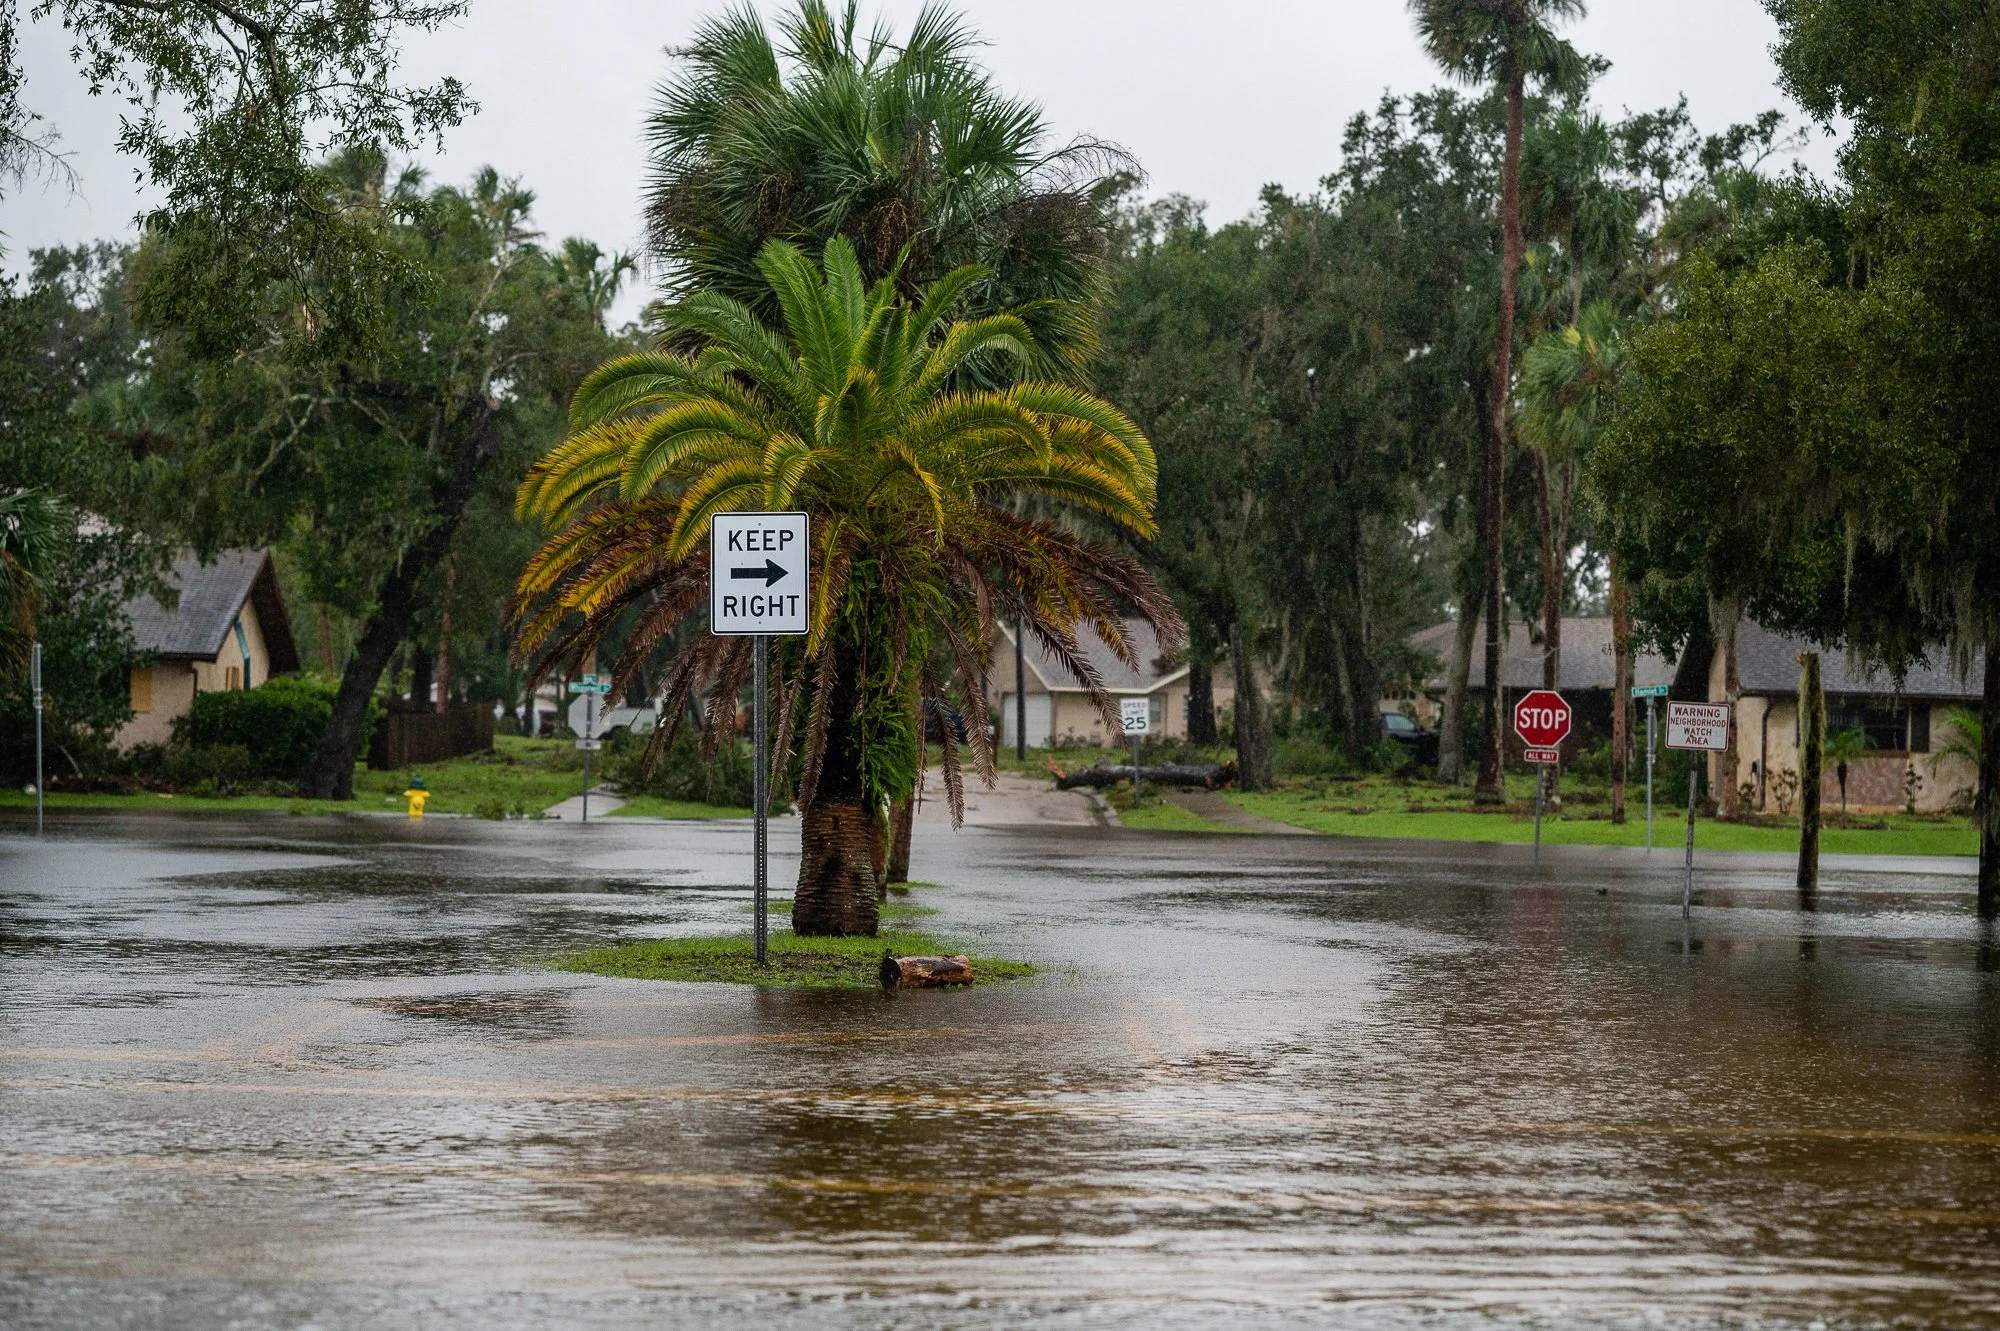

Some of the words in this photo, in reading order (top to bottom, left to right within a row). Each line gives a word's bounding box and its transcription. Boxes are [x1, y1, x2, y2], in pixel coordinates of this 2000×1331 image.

[728, 529, 794, 551] KEEP
[723, 595, 799, 617] RIGHT
[1674, 706, 1721, 718] WARNING
[1125, 717, 1146, 730] 25
[1519, 707, 1567, 730] STOP
[1670, 717, 1727, 728] NEIGHBORHOOD
[1684, 727, 1712, 736] WATCH
[1685, 736, 1709, 745] AREA
[1527, 752, 1540, 760] ALL
[1541, 752, 1555, 760] WAY
